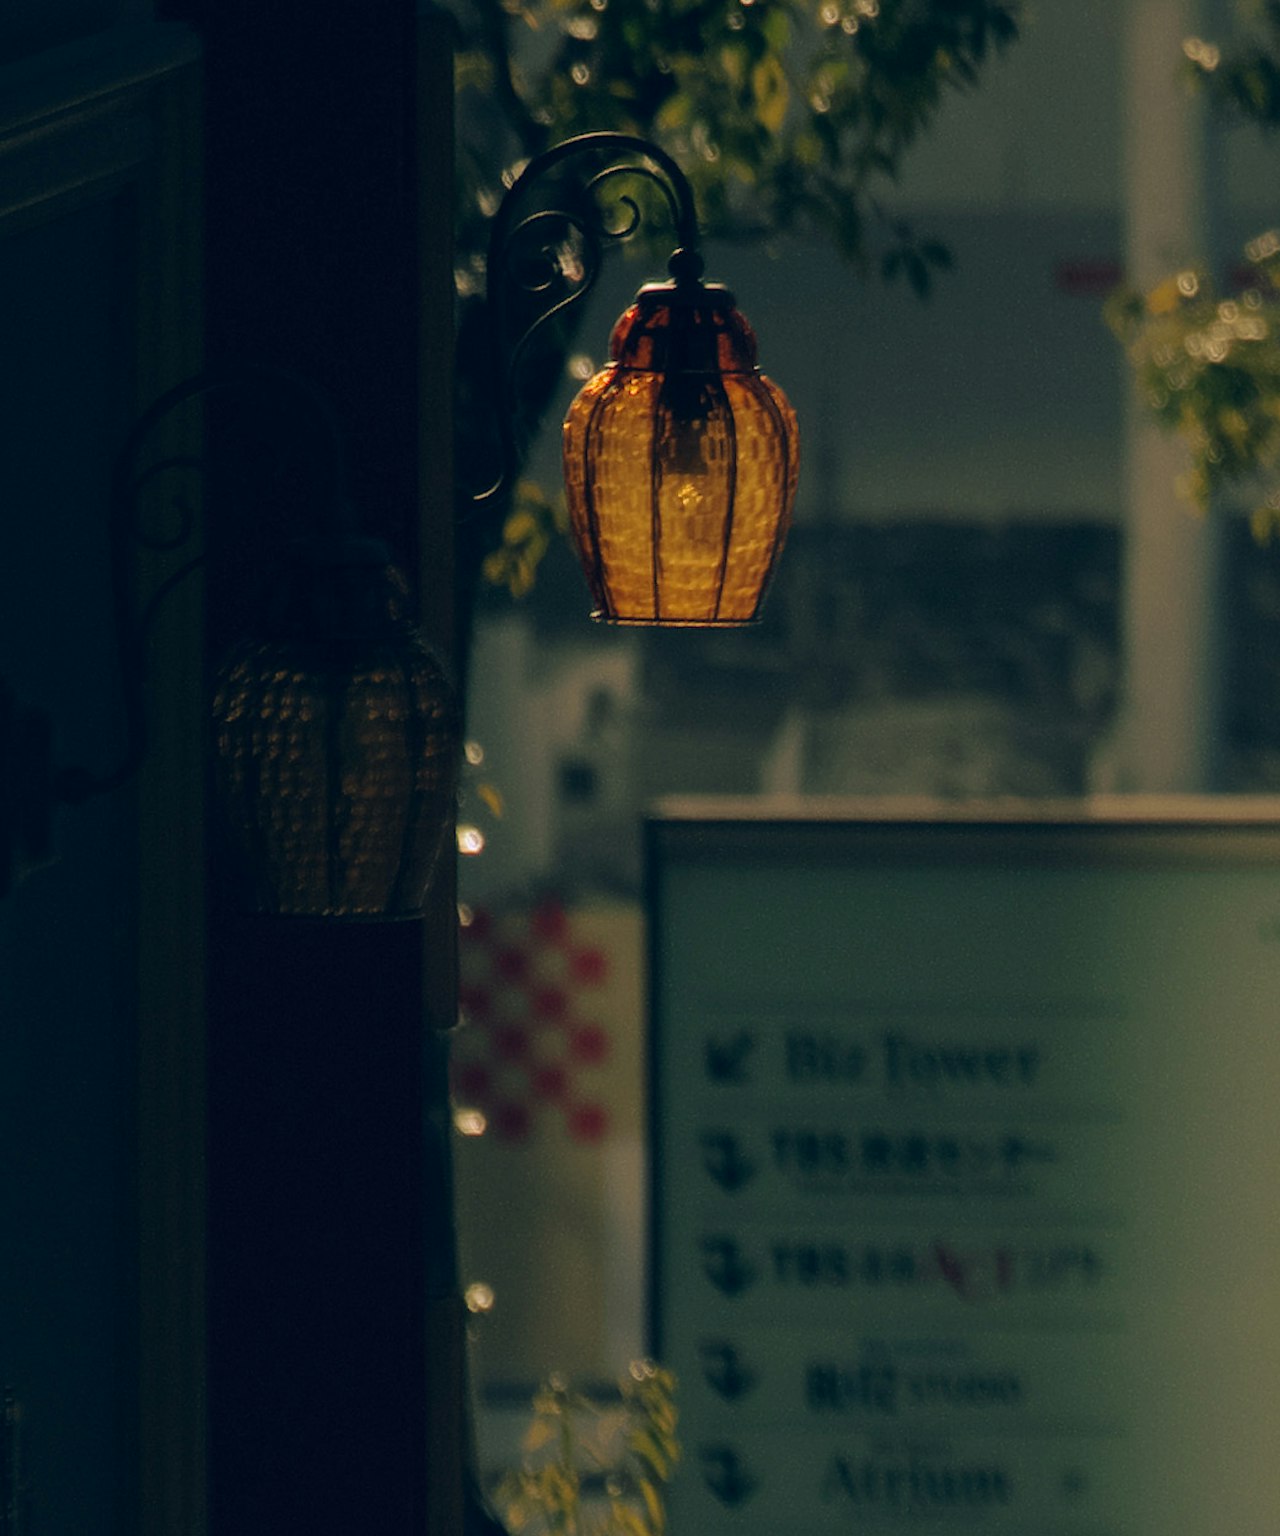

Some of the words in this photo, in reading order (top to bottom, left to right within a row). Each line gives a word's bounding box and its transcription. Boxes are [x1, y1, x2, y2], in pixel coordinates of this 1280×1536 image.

[786, 1033, 865, 1083] Biz
[885, 1031, 1040, 1084] Tower
[826, 1455, 1010, 1504] Atrium
